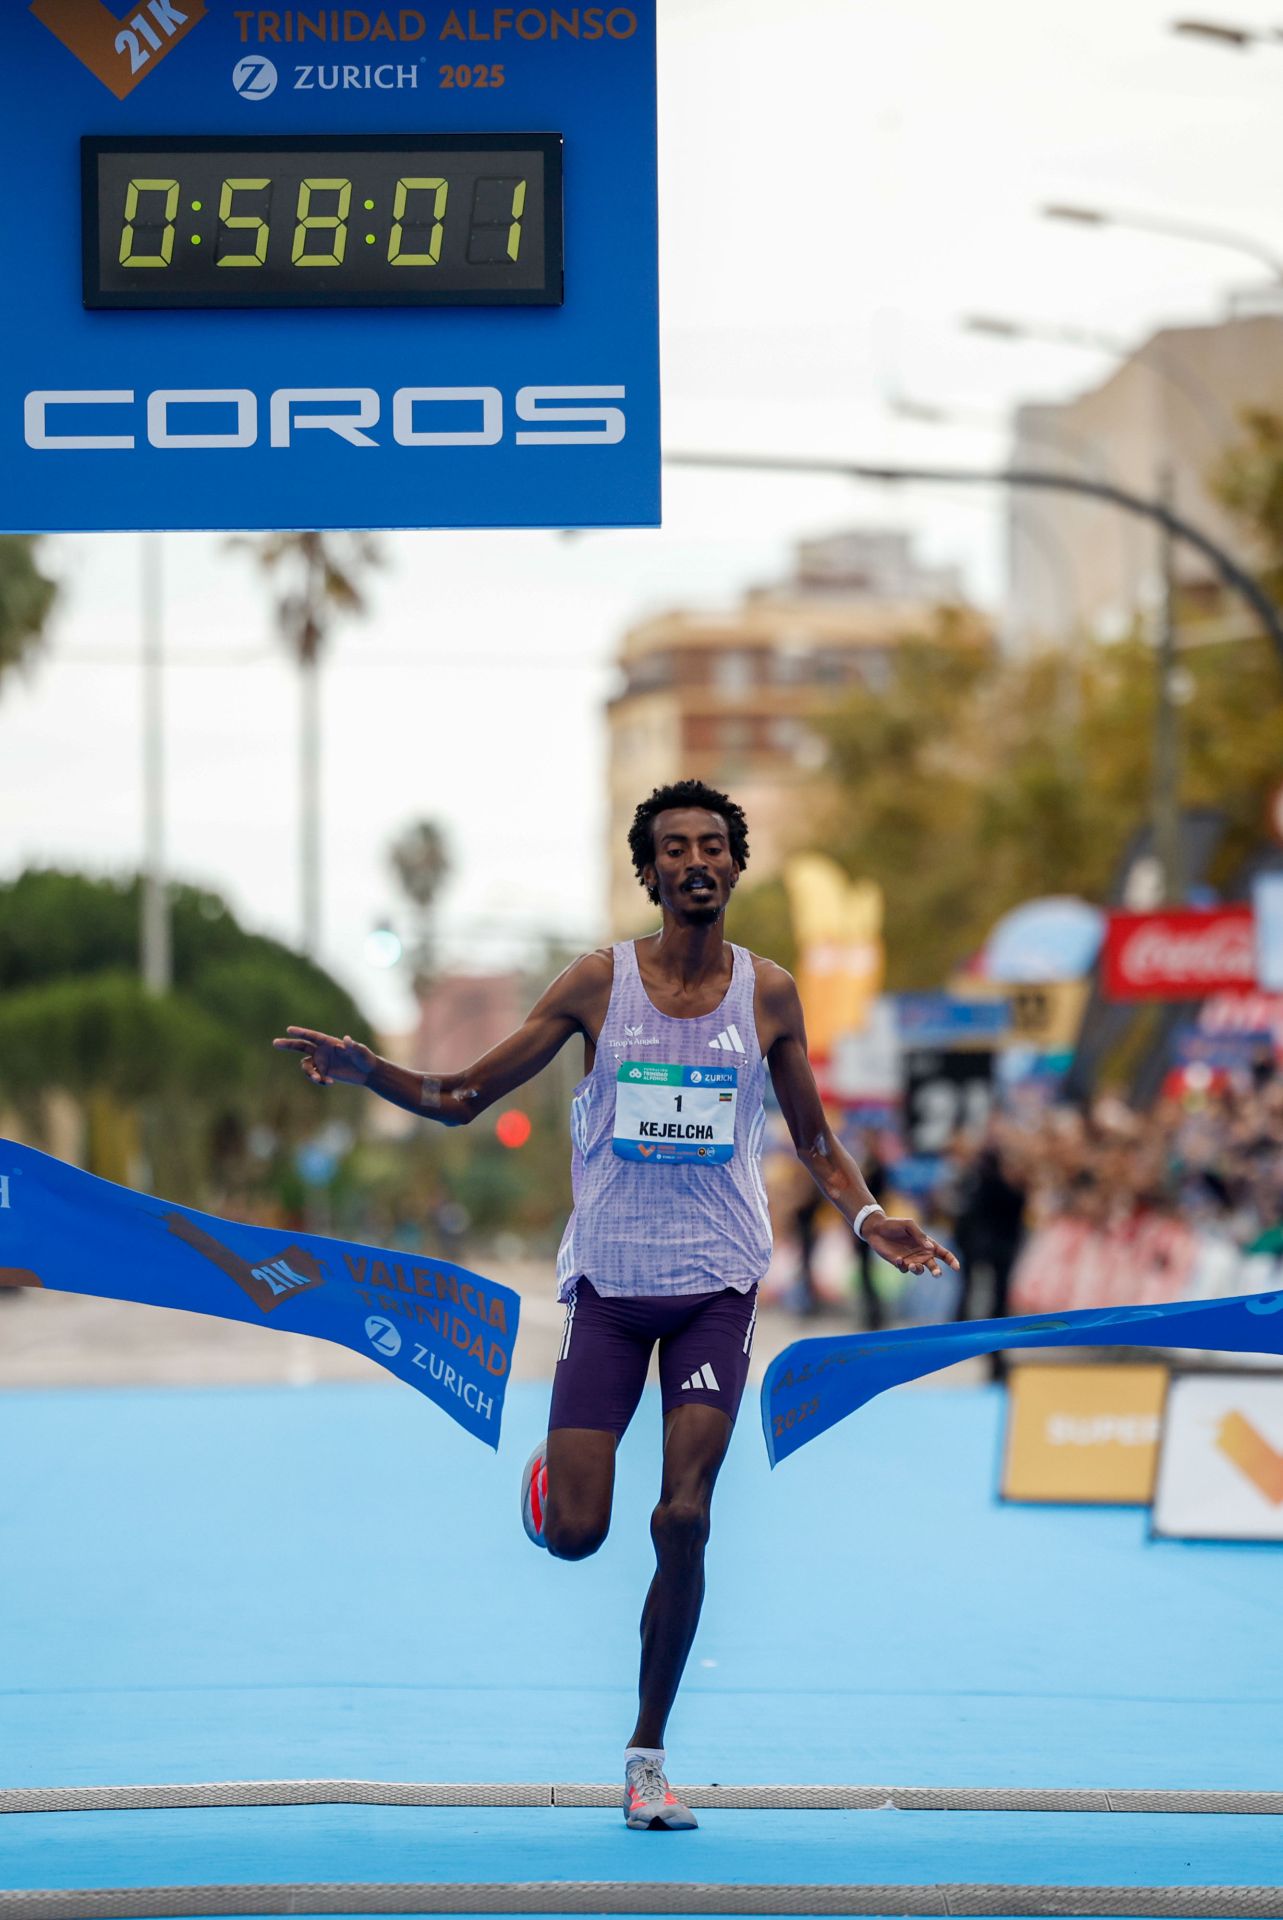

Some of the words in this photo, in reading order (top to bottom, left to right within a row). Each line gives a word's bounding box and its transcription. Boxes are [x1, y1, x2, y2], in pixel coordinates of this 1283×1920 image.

[114, 0, 189, 75] 21K
[233, 10, 426, 43] TRINIDAD
[438, 8, 638, 41] ALFONSO
[293, 64, 418, 89] ZURICH
[438, 64, 505, 89] 2025
[118, 177, 527, 268] 0:58:01
[24, 385, 626, 449] COROS
[704, 1073, 733, 1083] ZURICH
[674, 1094, 683, 1113] 1
[639, 1121, 714, 1140] KEJELCHA
[250, 1260, 312, 1296] 21K
[342, 1252, 508, 1335] VALENCIA
[353, 1288, 508, 1377] TRINIDAD
[411, 1342, 494, 1421] ZURICH
